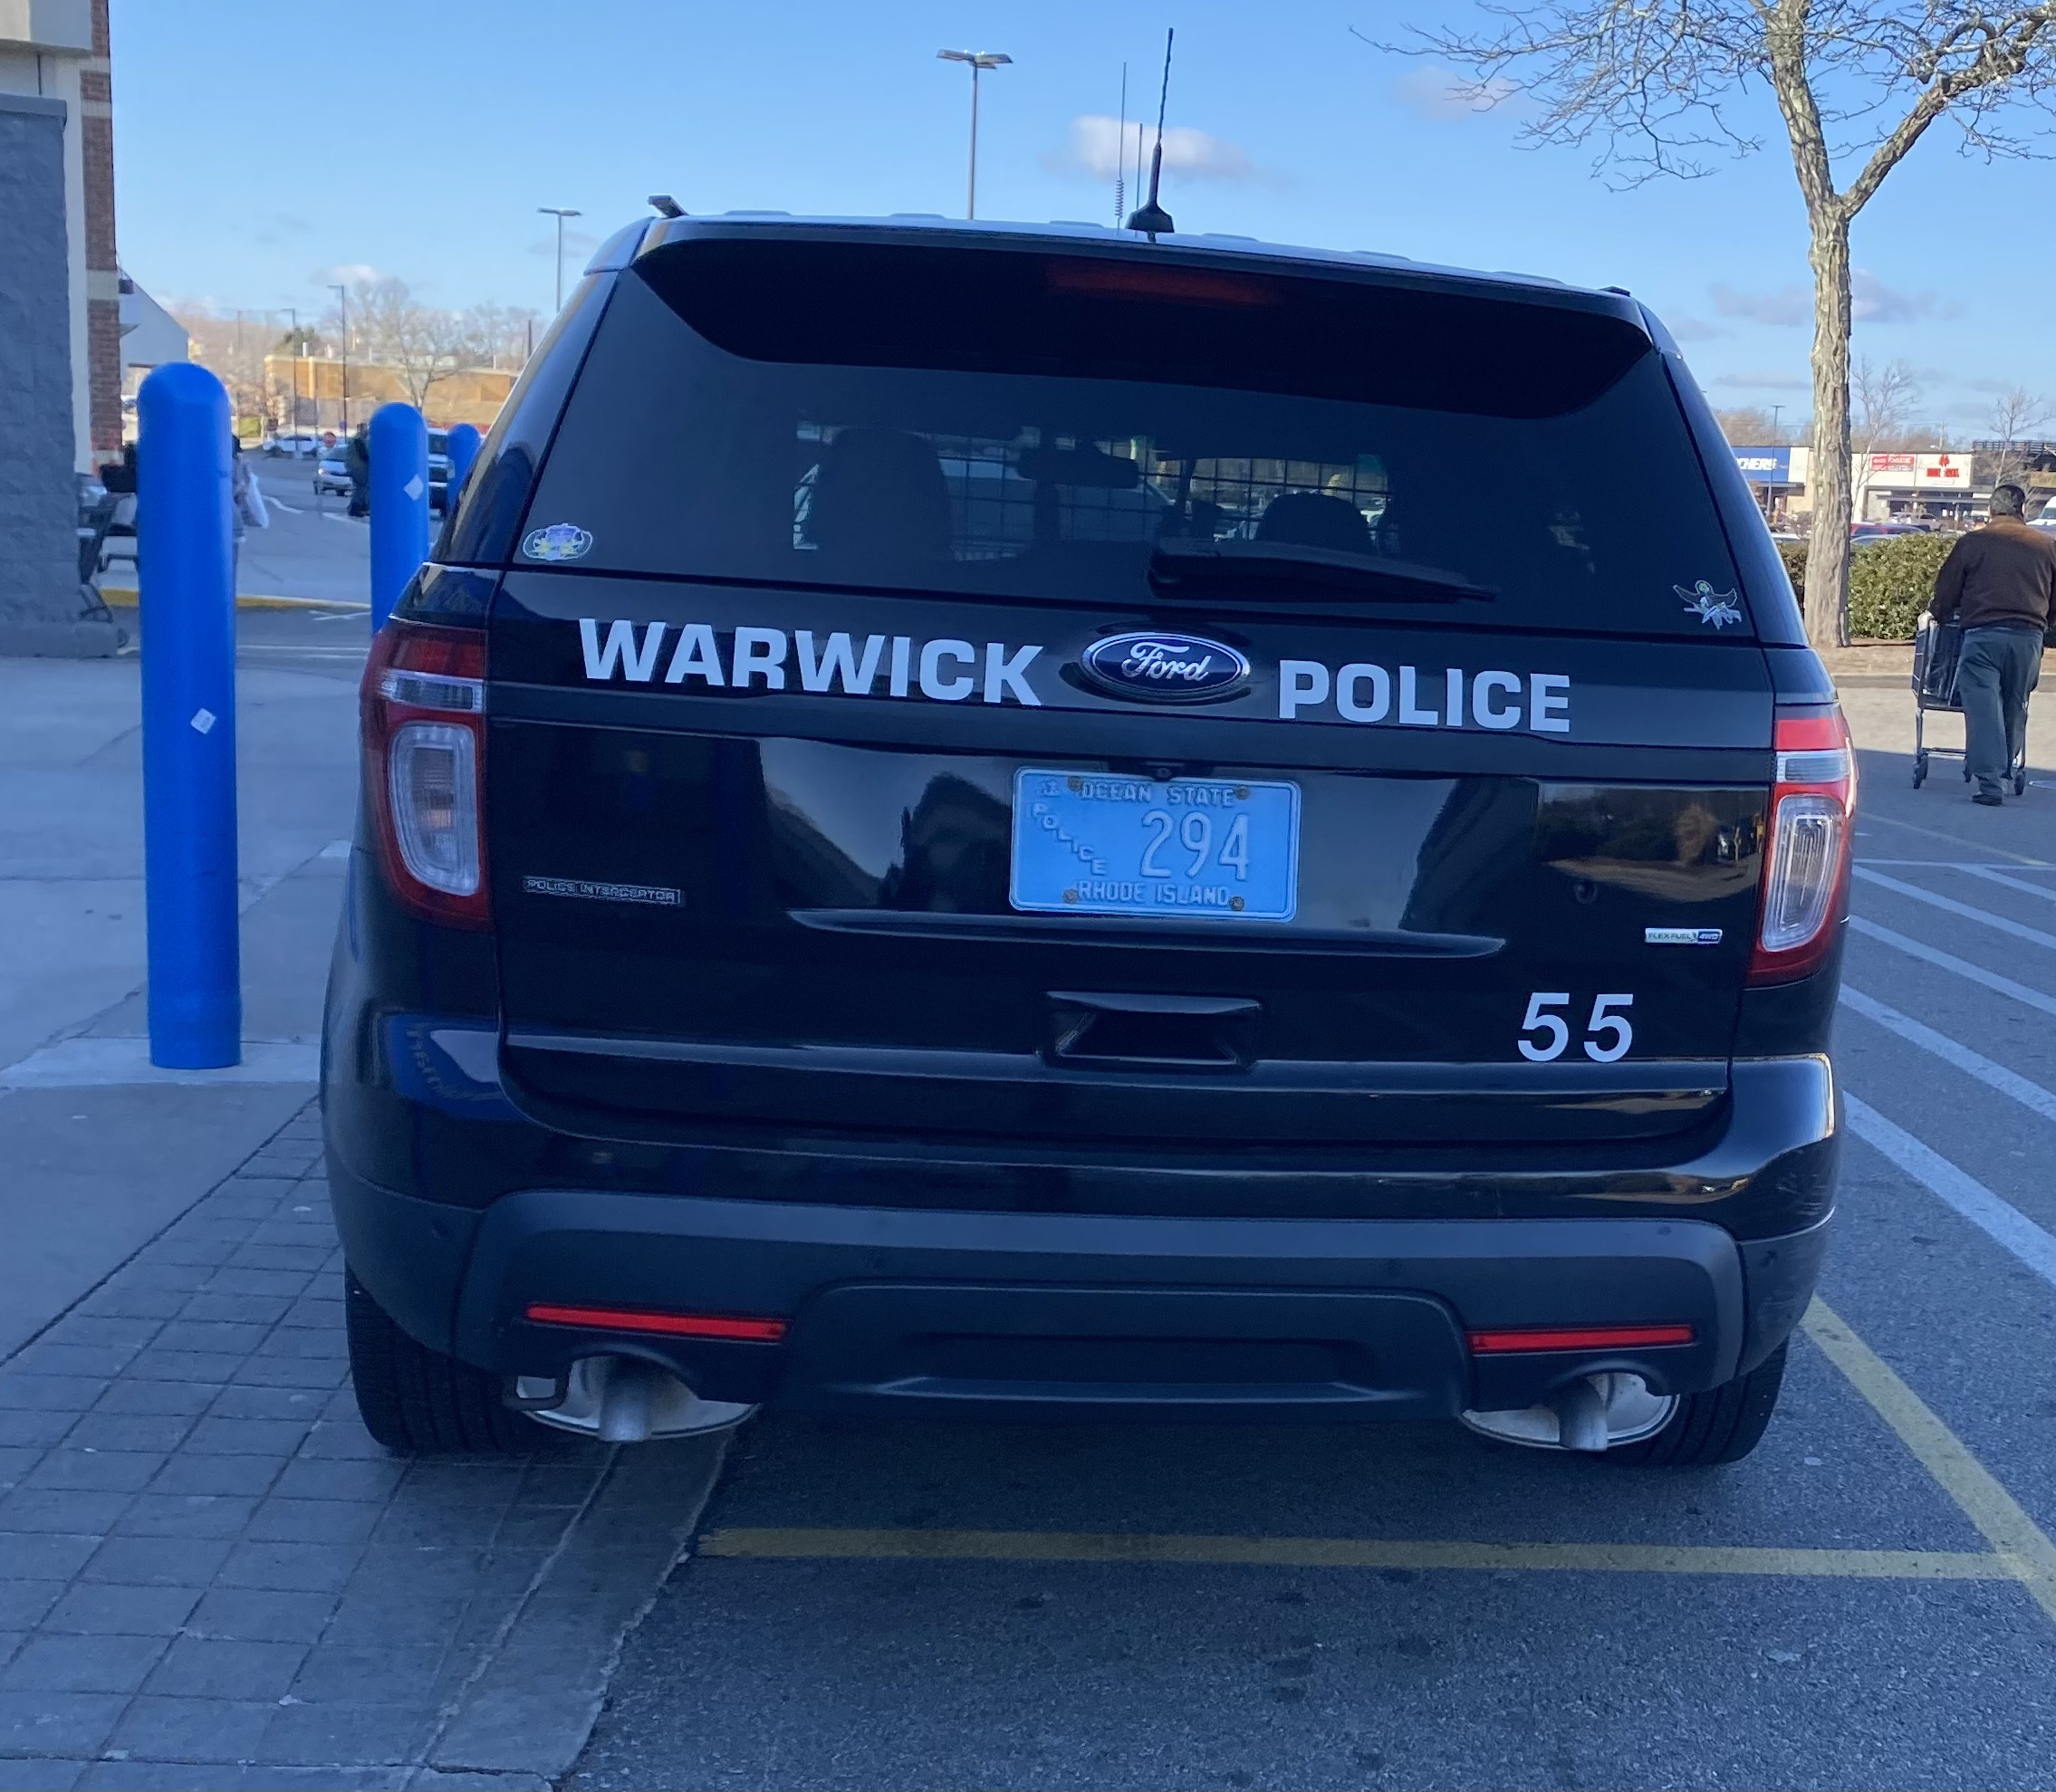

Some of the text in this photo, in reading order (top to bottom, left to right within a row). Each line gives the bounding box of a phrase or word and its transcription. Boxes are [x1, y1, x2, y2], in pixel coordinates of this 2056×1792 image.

[579, 618, 1571, 733] WARWICK POLICE
[1121, 641, 1212, 682] Ford
[1080, 782, 1234, 808] OCEAN STATE
[1030, 802, 1108, 875] POLICE
[1140, 809, 1250, 882] 294
[526, 879, 576, 893] POLICE
[1076, 881, 1229, 906] RHODE ISLAND
[1517, 992, 1634, 1063] 55
